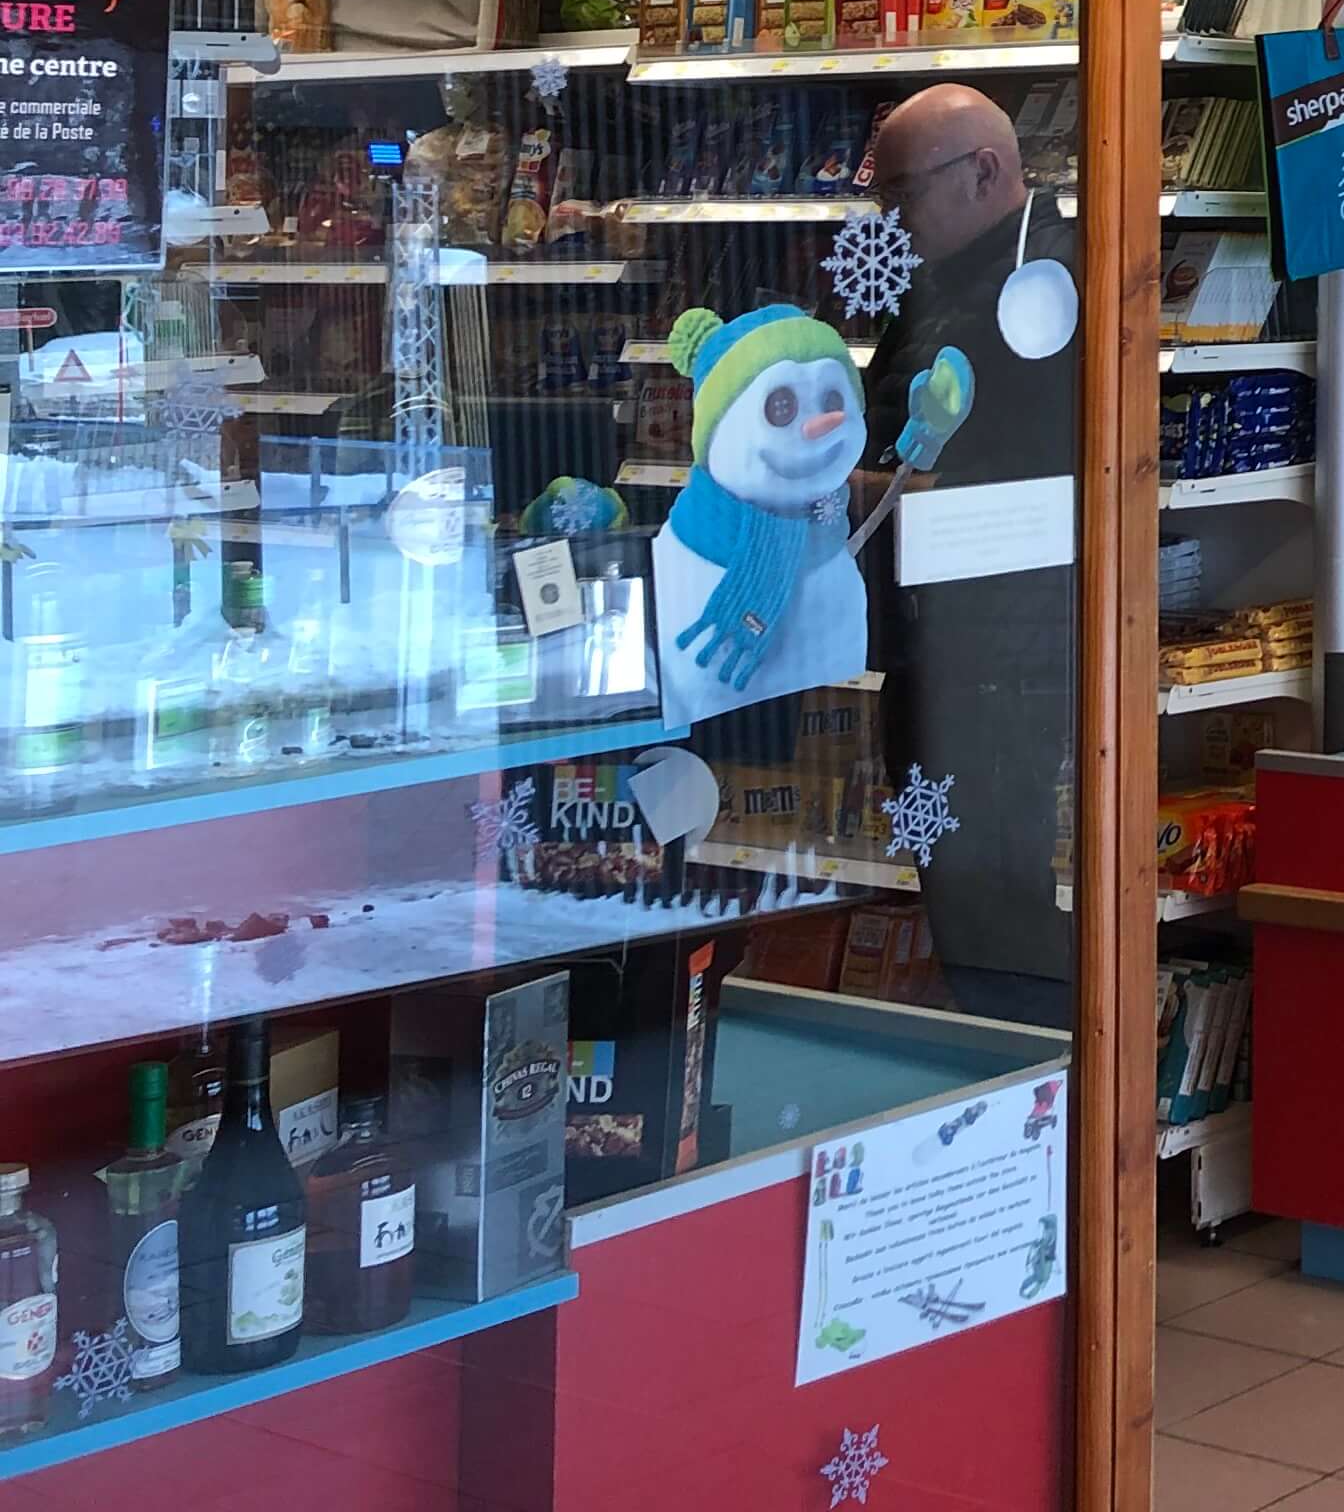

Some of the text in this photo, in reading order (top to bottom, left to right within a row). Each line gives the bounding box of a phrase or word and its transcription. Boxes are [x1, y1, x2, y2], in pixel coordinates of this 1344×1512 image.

[30, 55, 118, 77] centre
[10, 98, 101, 115] commerciale
[13, 123, 32, 139] de
[35, 123, 48, 139] la
[52, 123, 94, 139] Poste
[553, 777, 606, 802] BE-
[551, 800, 635, 830] KIND
[495, 1060, 558, 1093] CHIVAS REGAL
